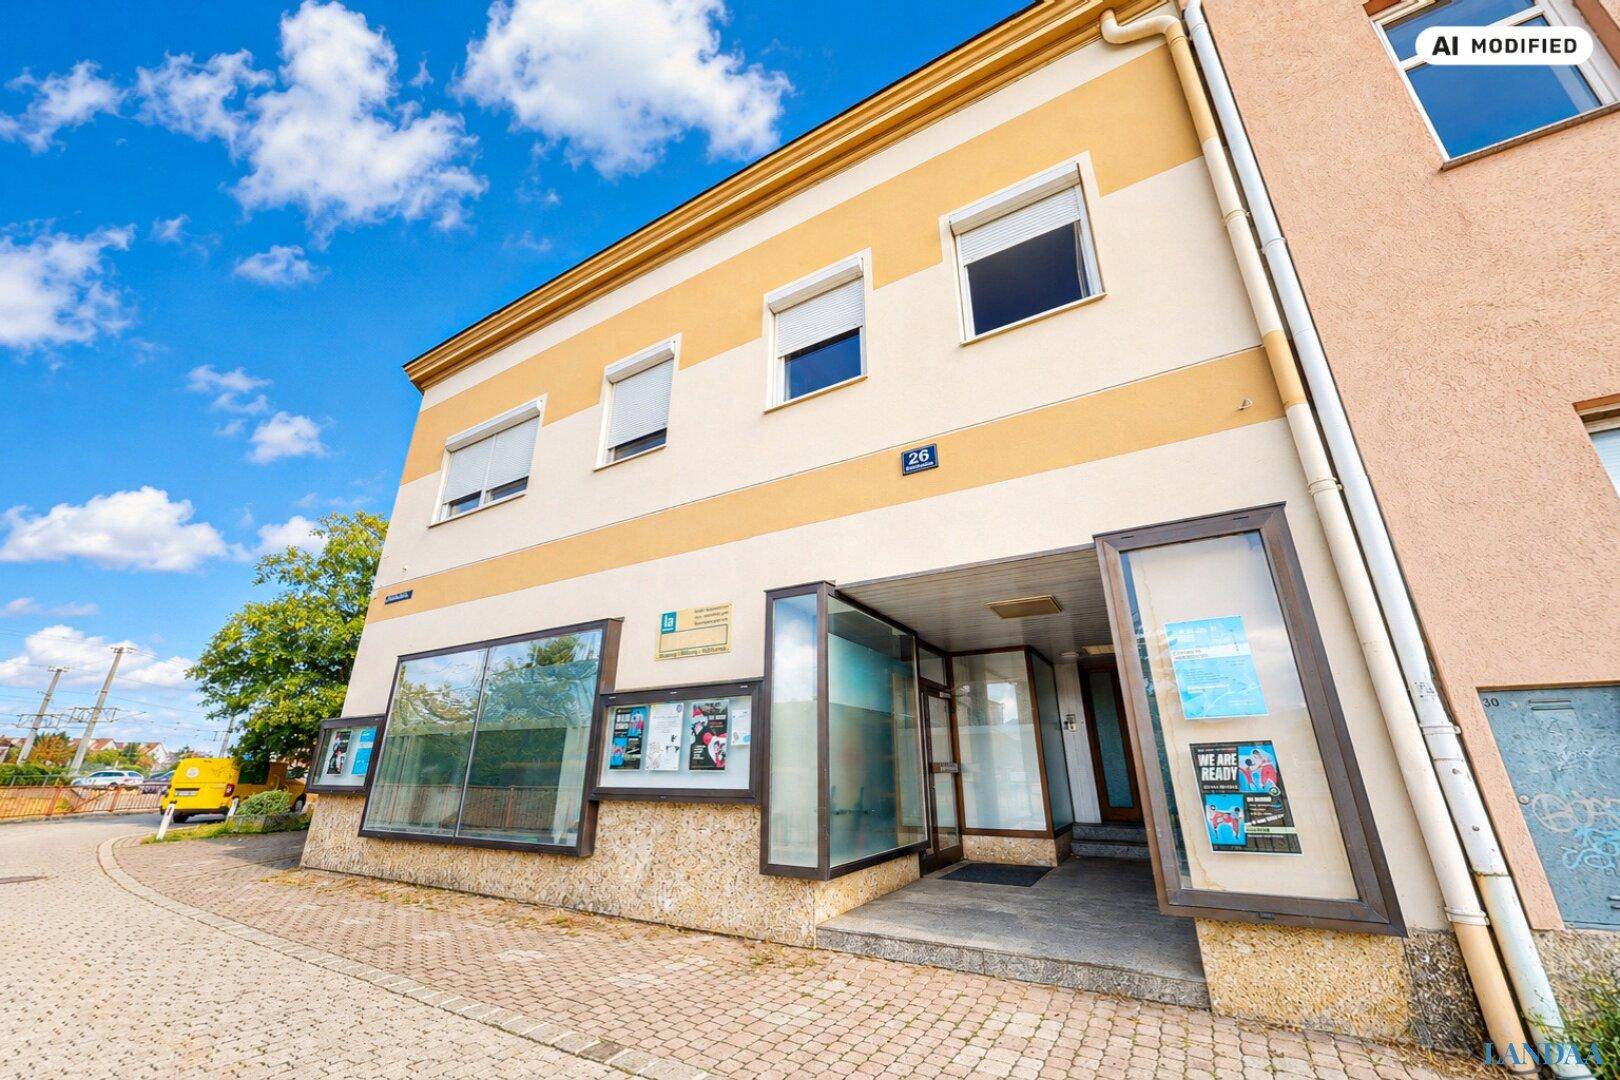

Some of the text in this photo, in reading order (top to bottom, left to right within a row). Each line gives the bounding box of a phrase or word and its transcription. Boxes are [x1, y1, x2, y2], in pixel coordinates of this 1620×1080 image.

[908, 449, 930, 466] 26
[1483, 697, 1499, 708] 30
[1197, 753, 1238, 767] WE ARE
[1201, 766, 1239, 781] READY
